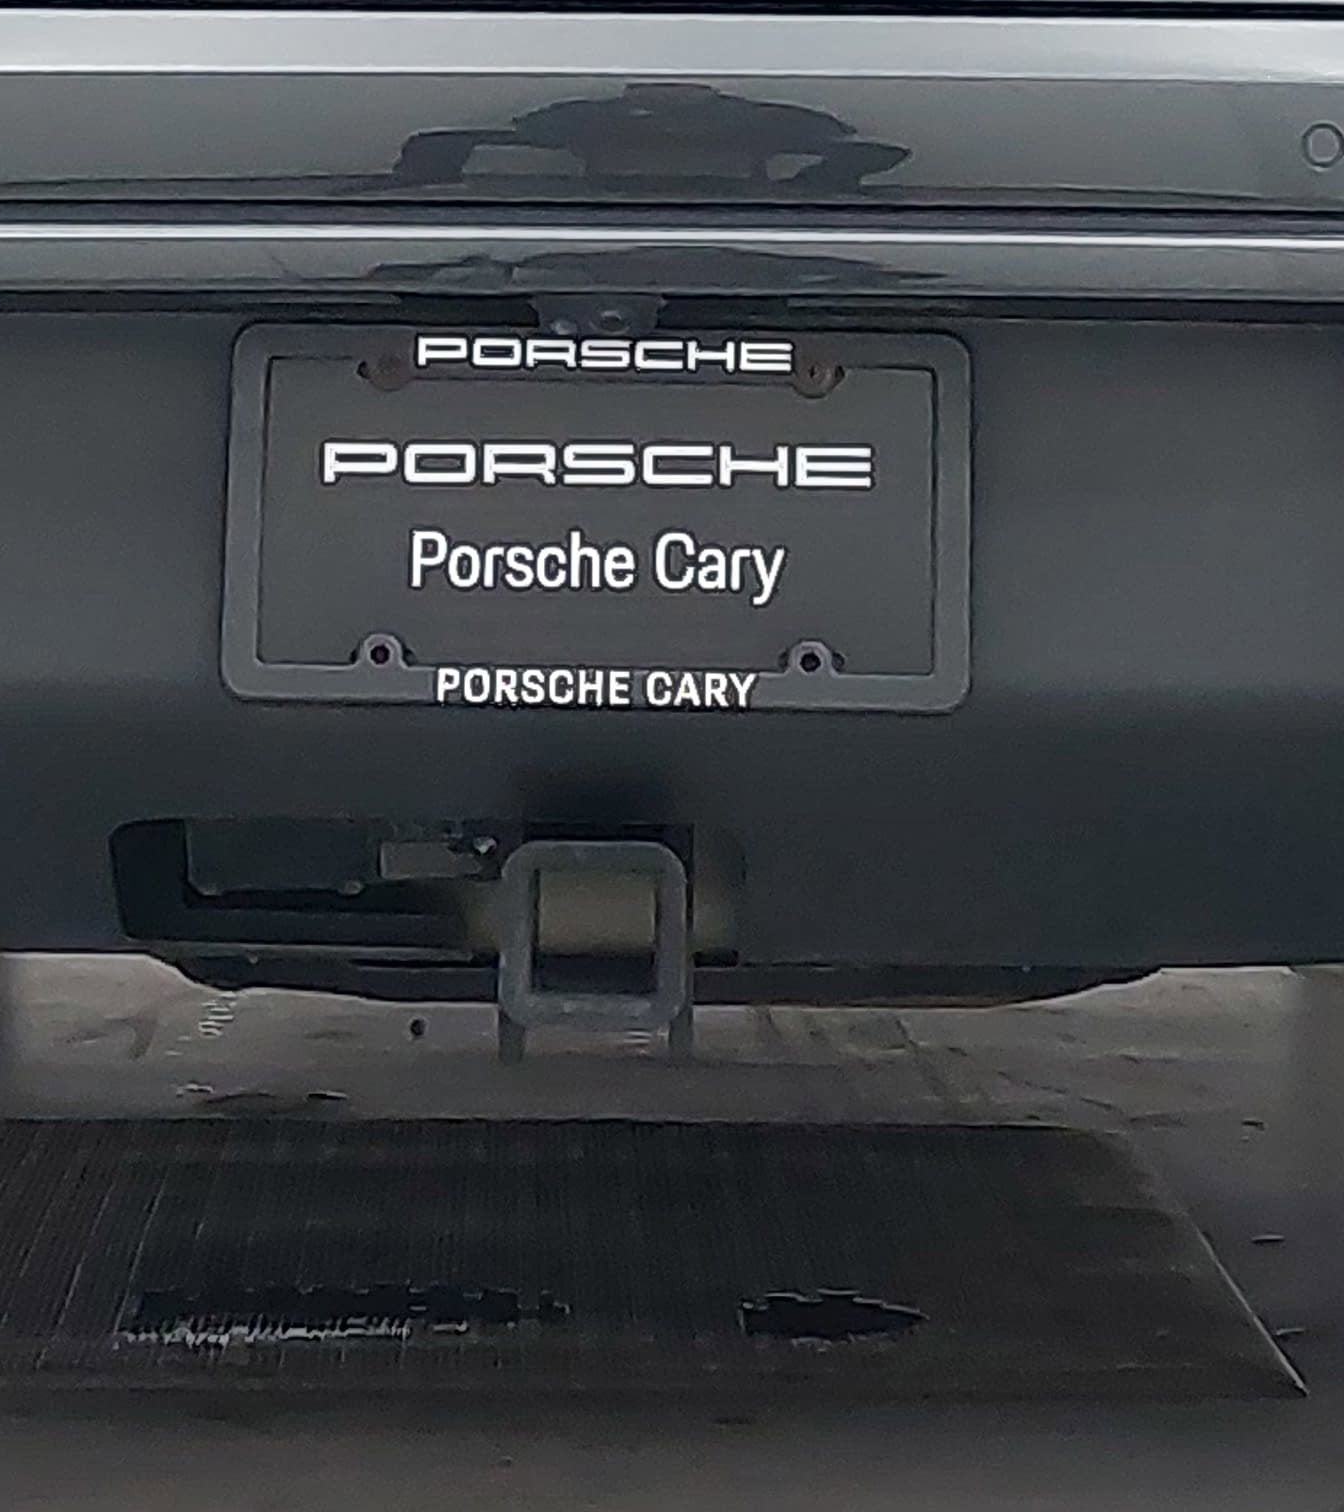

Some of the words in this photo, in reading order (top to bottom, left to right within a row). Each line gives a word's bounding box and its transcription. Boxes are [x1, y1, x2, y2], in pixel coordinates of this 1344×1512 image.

[417, 336, 794, 372] PORSCHE
[323, 441, 872, 487] PORSCHE
[410, 530, 636, 589] Porsche
[655, 531, 785, 606] Cary
[436, 667, 631, 706] PORSCHE
[643, 670, 757, 708] CARY
